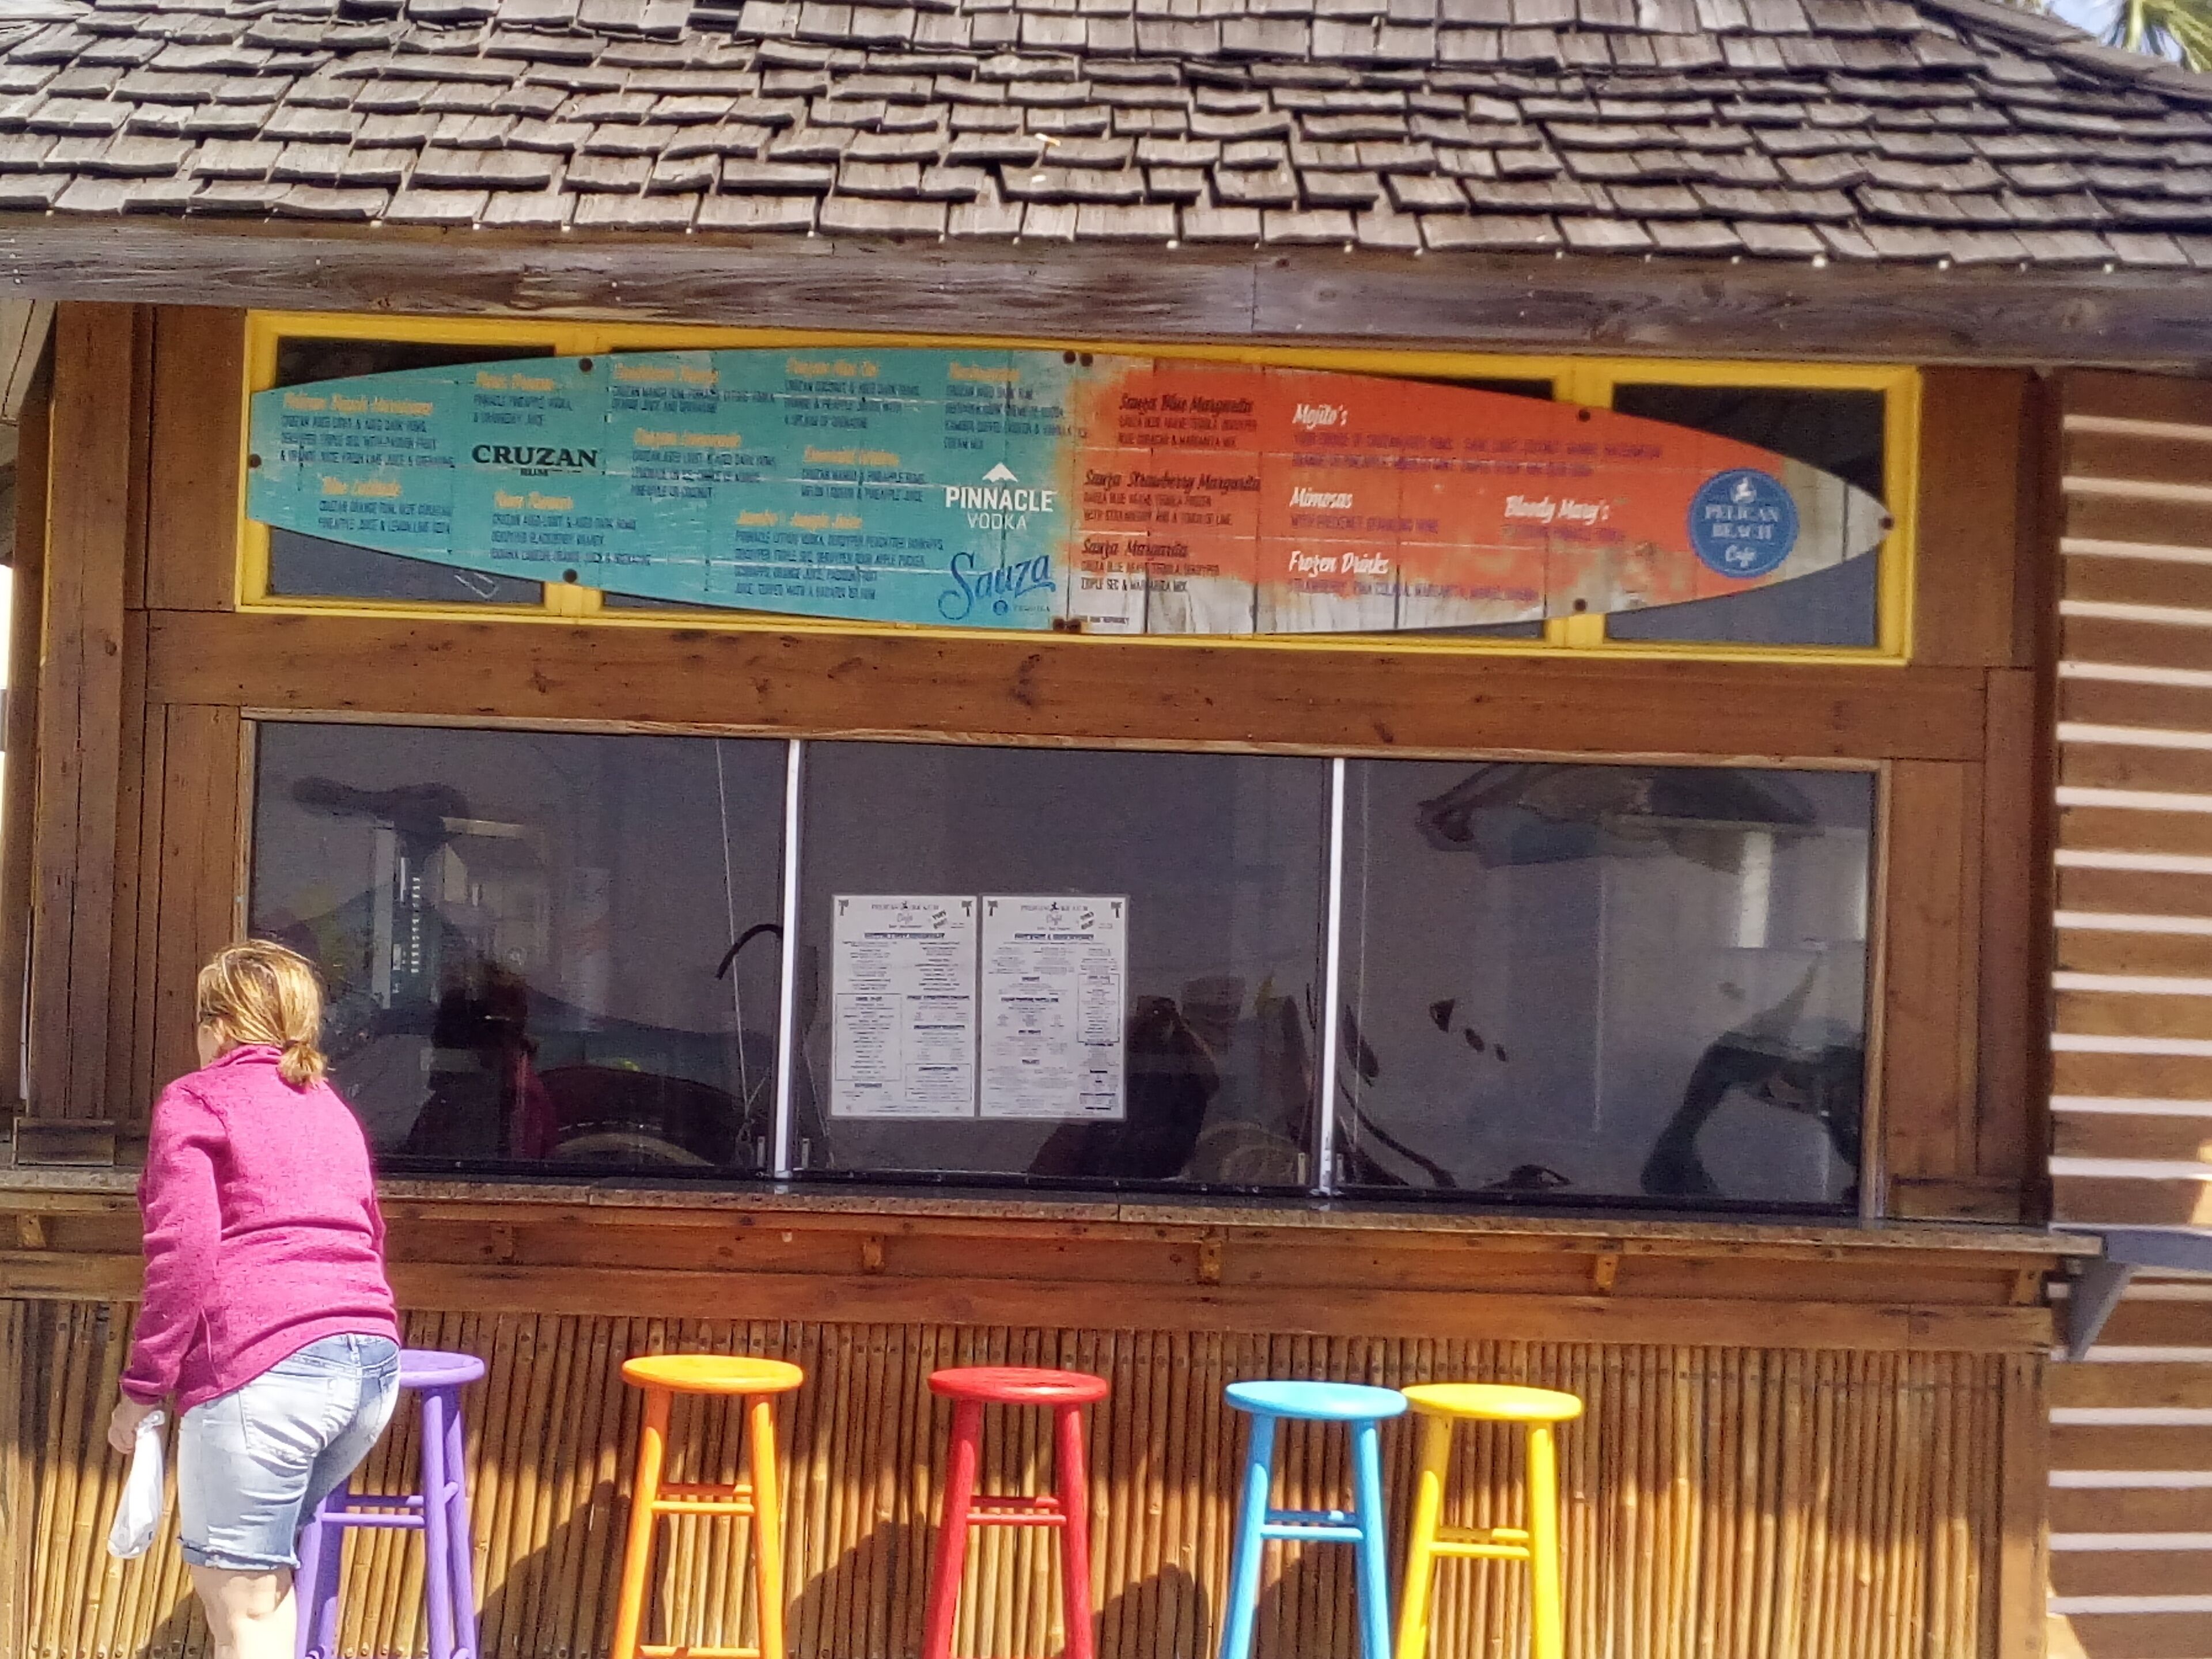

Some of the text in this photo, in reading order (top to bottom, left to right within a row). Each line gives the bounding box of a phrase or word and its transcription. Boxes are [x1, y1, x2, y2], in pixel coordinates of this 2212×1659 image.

[1292, 403, 1348, 430] Mojito's
[471, 444, 598, 468] CRUZAN
[945, 487, 1056, 512] PINNACLE
[1289, 487, 1353, 509] Mimosas
[967, 512, 1027, 530] VODKA
[1289, 551, 1336, 578] Frozen
[938, 551, 1056, 620] Sauza
